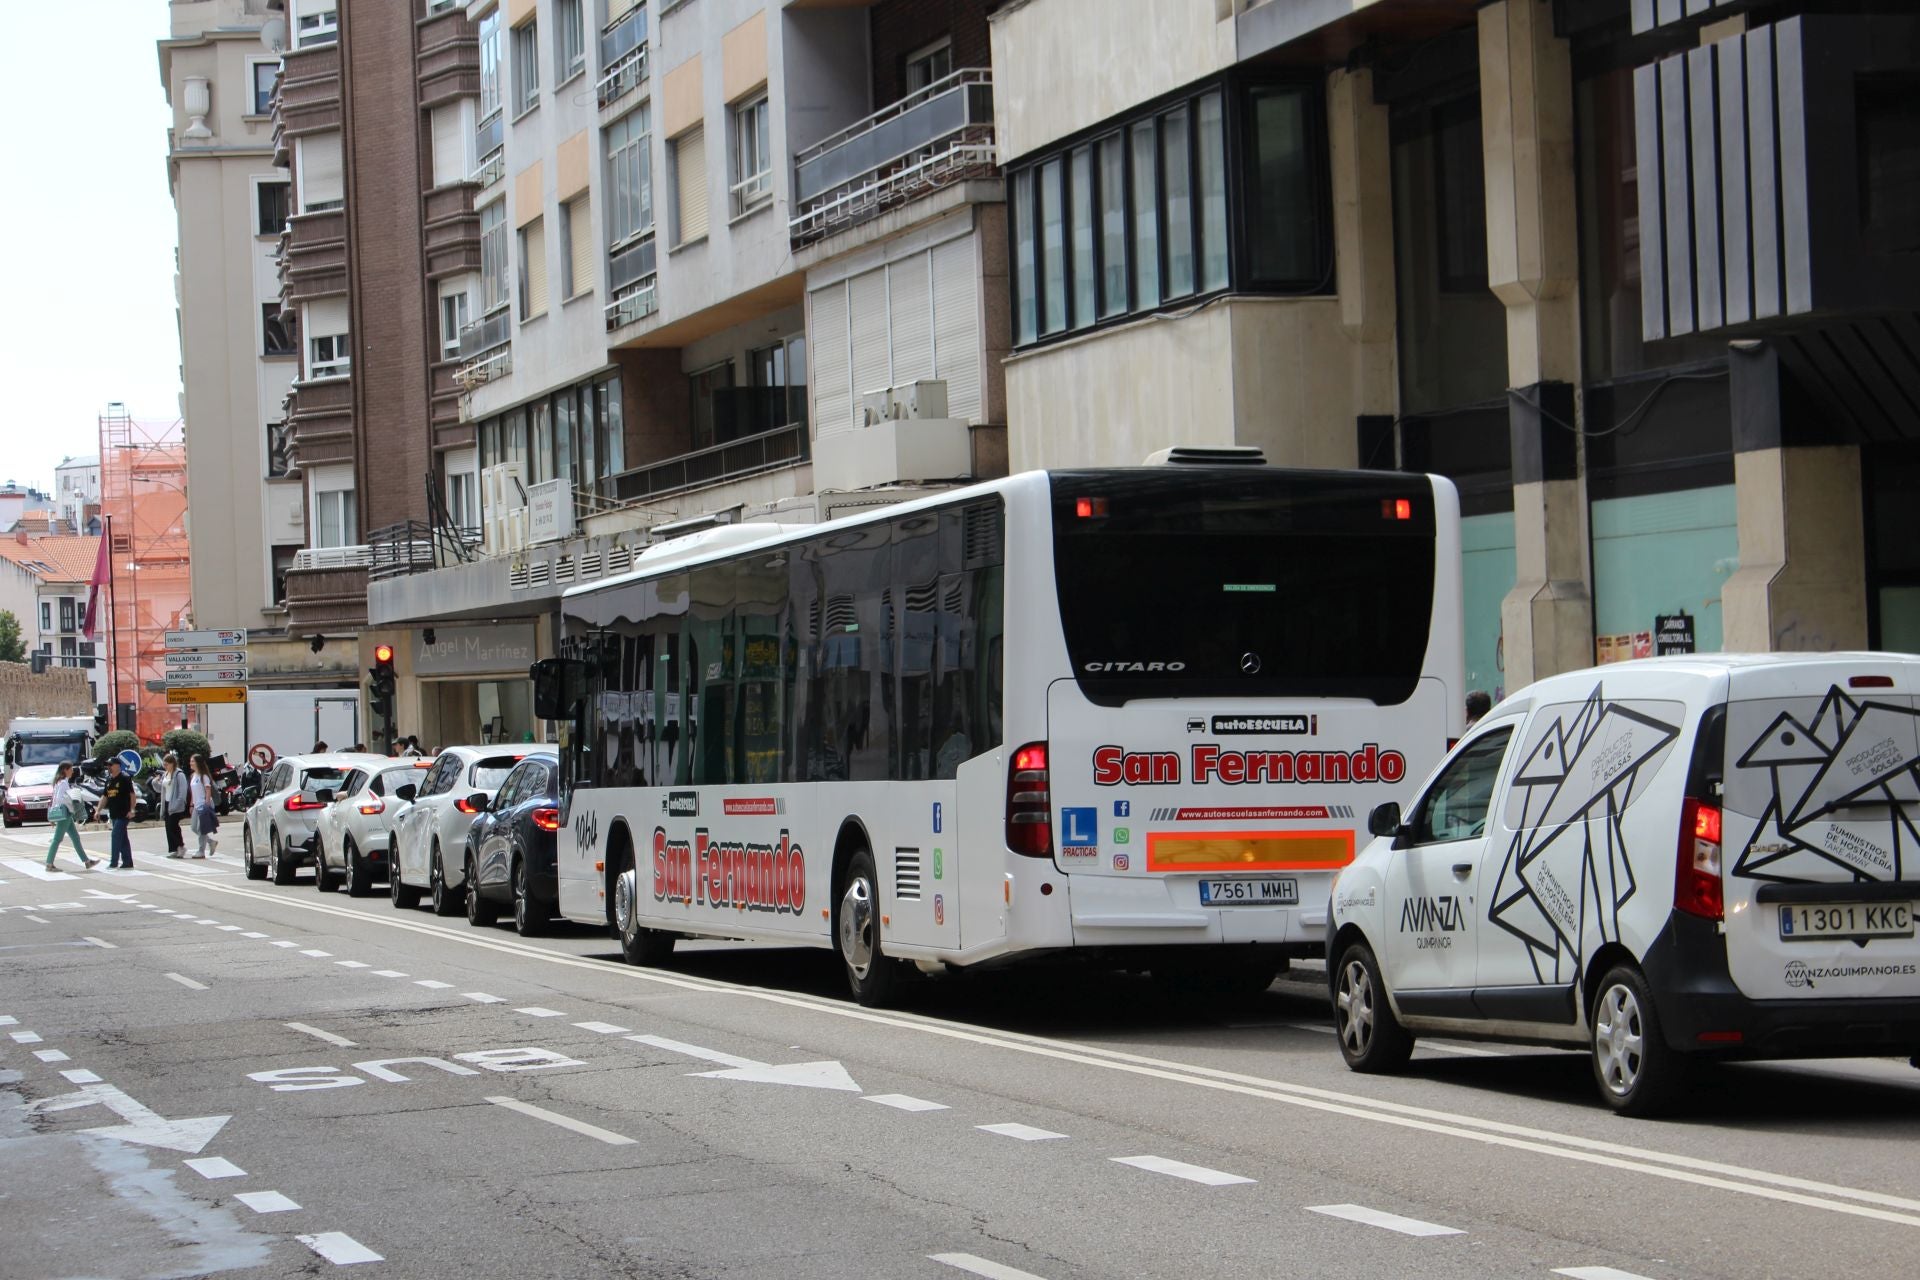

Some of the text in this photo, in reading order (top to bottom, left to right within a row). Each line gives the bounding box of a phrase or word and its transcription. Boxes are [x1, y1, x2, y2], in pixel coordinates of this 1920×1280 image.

[465, 637, 528, 661] Martínez
[1084, 661, 1186, 672] CITARO
[1215, 719, 1305, 731] autoESCUELA
[1094, 743, 1406, 785] San Fernando
[1603, 752, 1632, 781] BOLSAS
[1845, 737, 1895, 767] PRODUCTOS
[1851, 746, 1899, 776] DE LIMPIEZA
[1870, 753, 1904, 776] BOLSAS
[1070, 814, 1088, 840] L
[1182, 809, 1323, 819] www.autoescuelasanfernando.com
[576, 809, 597, 860] 1964
[1830, 823, 1888, 859] SUMINISTROS
[1062, 847, 1097, 857] PRACTICAS
[1824, 840, 1869, 869] TAKE AWAY
[1826, 831, 1893, 873] DE HOSTELERÍA
[653, 826, 806, 917] San Fernando
[1213, 882, 1253, 899] 7561
[1261, 881, 1292, 898] MMH
[1541, 860, 1575, 915] SUMINISTROS
[1400, 896, 1465, 932] AVANZA
[1801, 907, 1855, 931] 1301
[1865, 906, 1908, 930] KKC
[1416, 936, 1452, 950] QUIMPANOR
